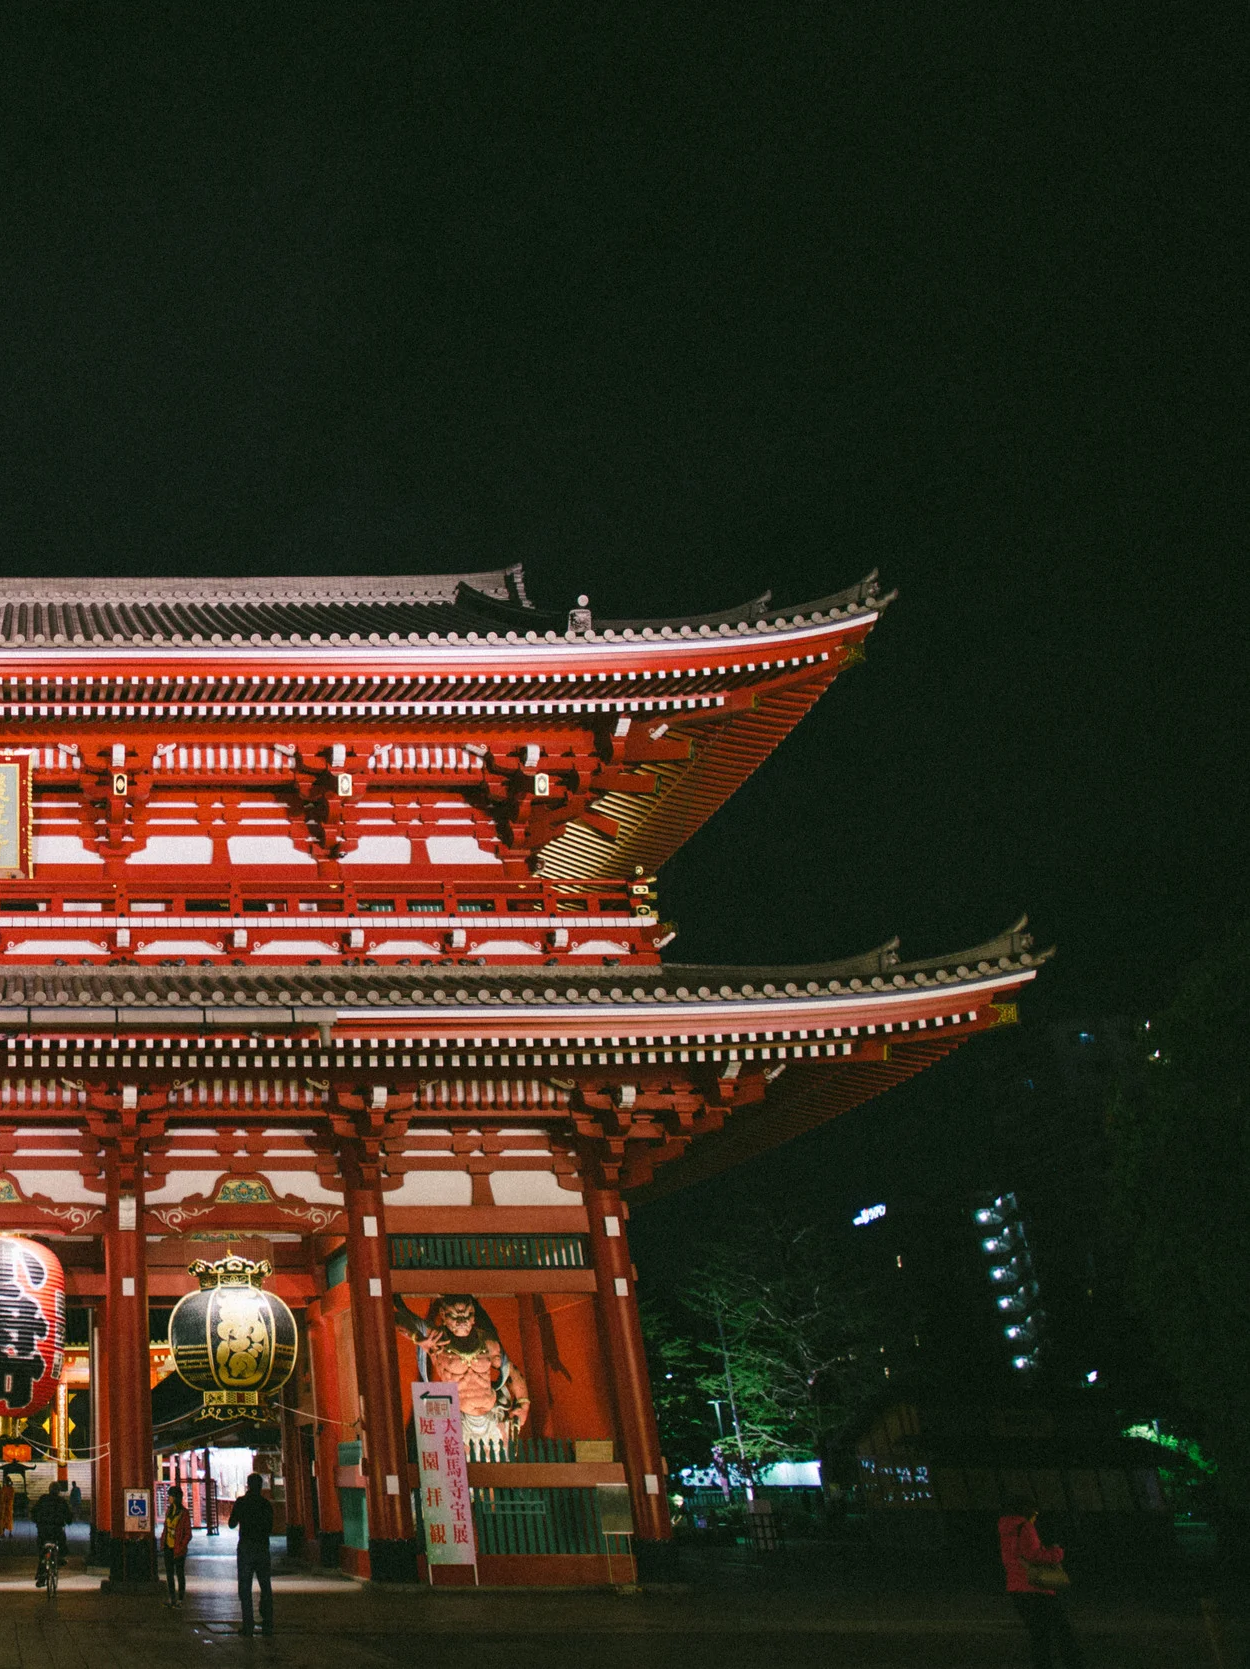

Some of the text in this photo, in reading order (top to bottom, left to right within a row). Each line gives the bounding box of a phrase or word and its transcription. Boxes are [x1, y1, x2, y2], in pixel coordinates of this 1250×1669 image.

[420, 1417, 447, 1544] 庭園拝観
[442, 1417, 469, 1544] 大絵馬寺宝展
